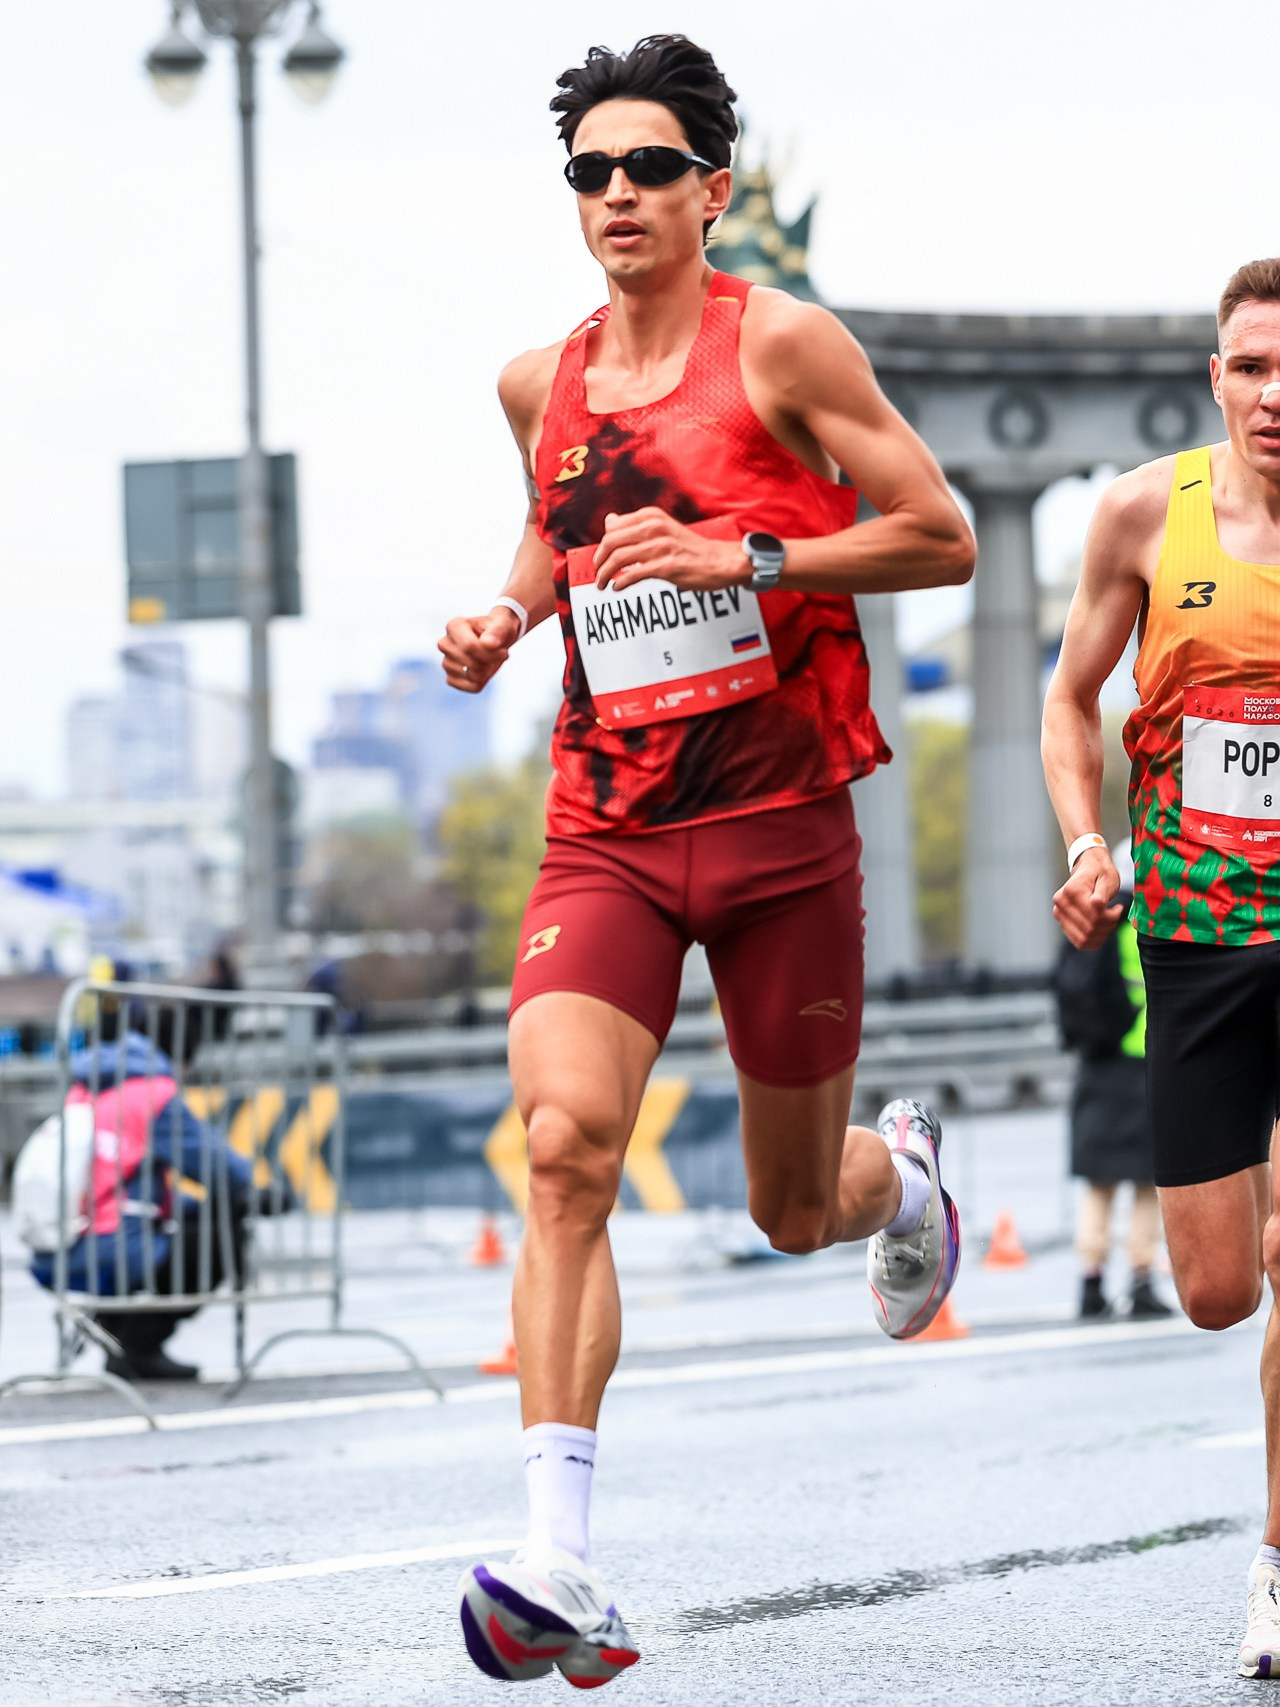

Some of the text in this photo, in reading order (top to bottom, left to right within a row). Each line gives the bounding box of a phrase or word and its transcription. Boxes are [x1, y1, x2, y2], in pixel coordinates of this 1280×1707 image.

[585, 585, 741, 645] AKHMADEYEV
[663, 651, 674, 666] 5
[1243, 705, 1268, 713] ПОЛУ
[1263, 794, 1273, 808] 8
